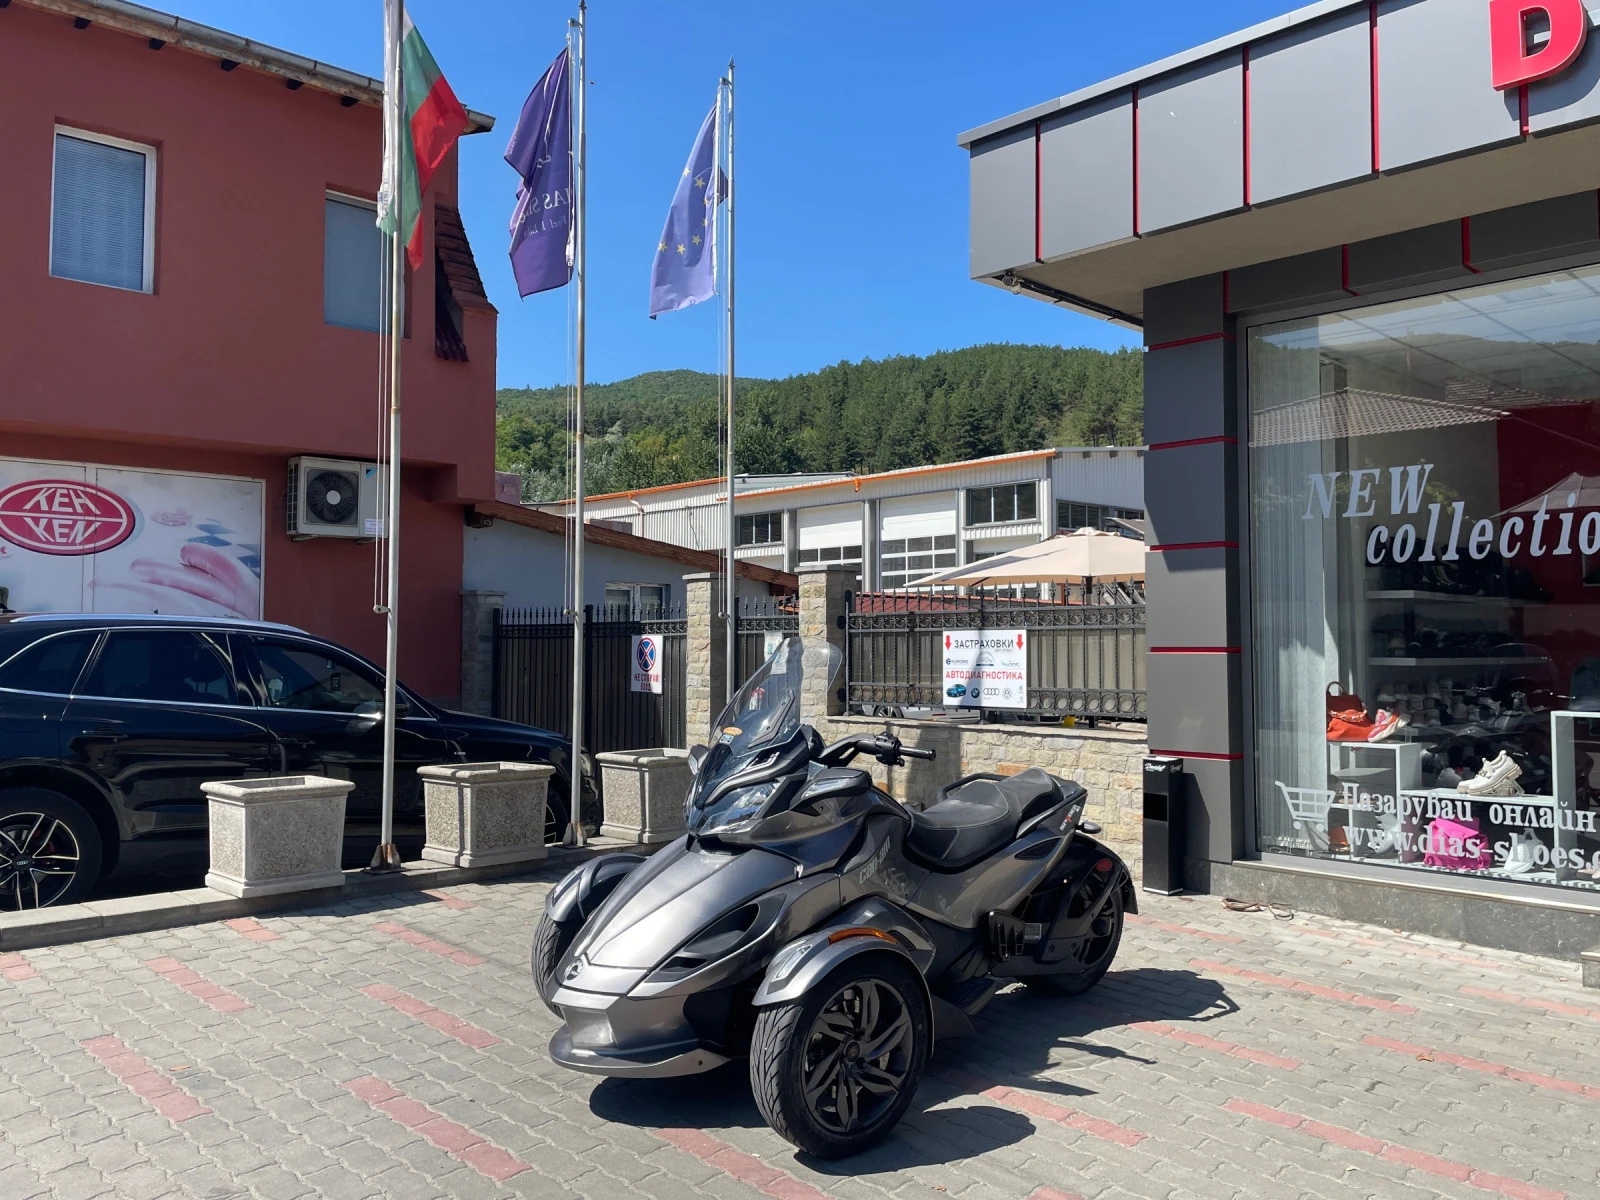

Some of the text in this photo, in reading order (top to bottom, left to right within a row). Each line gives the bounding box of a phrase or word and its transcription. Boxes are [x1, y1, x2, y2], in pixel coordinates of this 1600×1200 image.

[1489, 0, 1588, 91] D
[23, 487, 101, 515] КЕН
[1302, 463, 1435, 520] NEW
[24, 517, 102, 543] KEN
[1366, 492, 1600, 564] collectio
[954, 639, 1014, 649] ЗАСТРАХОВКИ
[945, 670, 1023, 680] АВТОДИАГНОСТИКА
[1342, 782, 1597, 833] Пазарувай онлайн
